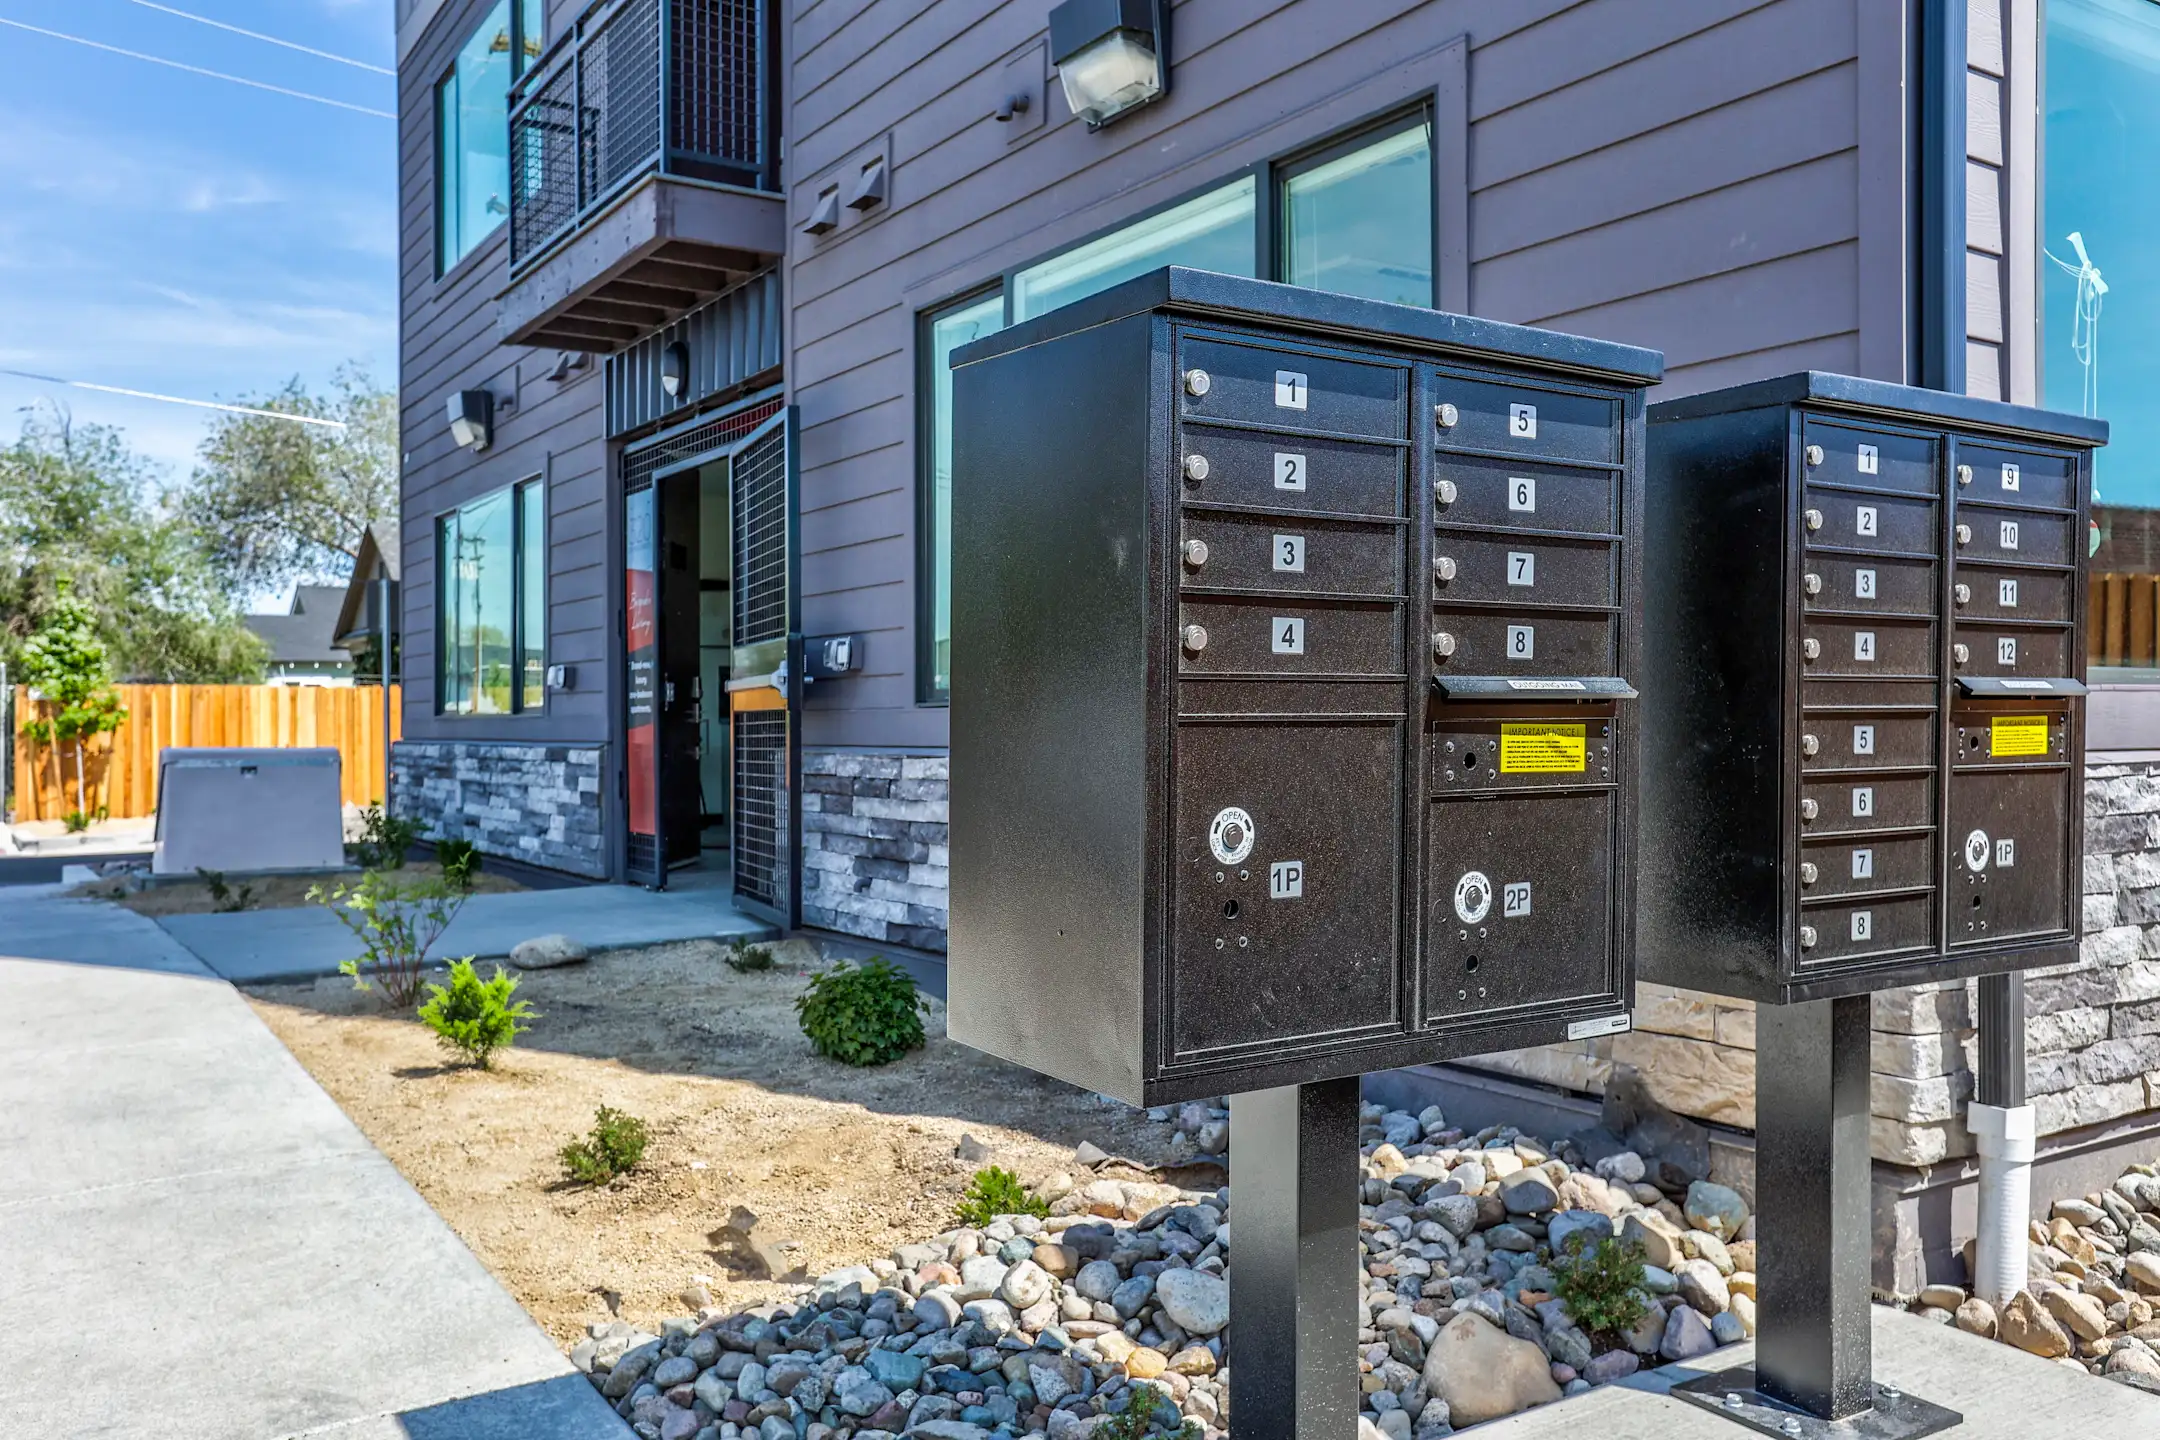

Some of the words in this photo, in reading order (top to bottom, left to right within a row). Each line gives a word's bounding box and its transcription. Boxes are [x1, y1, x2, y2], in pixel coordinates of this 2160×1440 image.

[1287, 377, 1297, 402] 1
[1518, 409, 1529, 432] 5
[1284, 459, 1297, 484] 2
[2007, 467, 2014, 485] 9
[1517, 483, 1528, 506] 6
[1863, 512, 1871, 531] 2
[2002, 526, 2016, 544] 10
[1282, 541, 1295, 566] 3
[1515, 557, 1527, 580] 7
[1862, 574, 1870, 593] 3
[2002, 584, 2015, 602] 11
[1281, 623, 1295, 648] 4
[1515, 631, 1526, 653] 8
[1860, 637, 1869, 656] 4
[2000, 642, 2014, 660] 12
[1509, 727, 1550, 736] IMPORTANT
[1859, 730, 1868, 749] 5
[1858, 792, 1867, 812] 6
[1222, 811, 1244, 822] OPEN
[1998, 843, 2012, 861] 1P
[1858, 854, 1866, 873] 7
[1272, 867, 1300, 893] 1P
[1465, 874, 1483, 885] OPEN
[1506, 887, 1529, 912] 2P
[1857, 916, 1865, 935] 8
